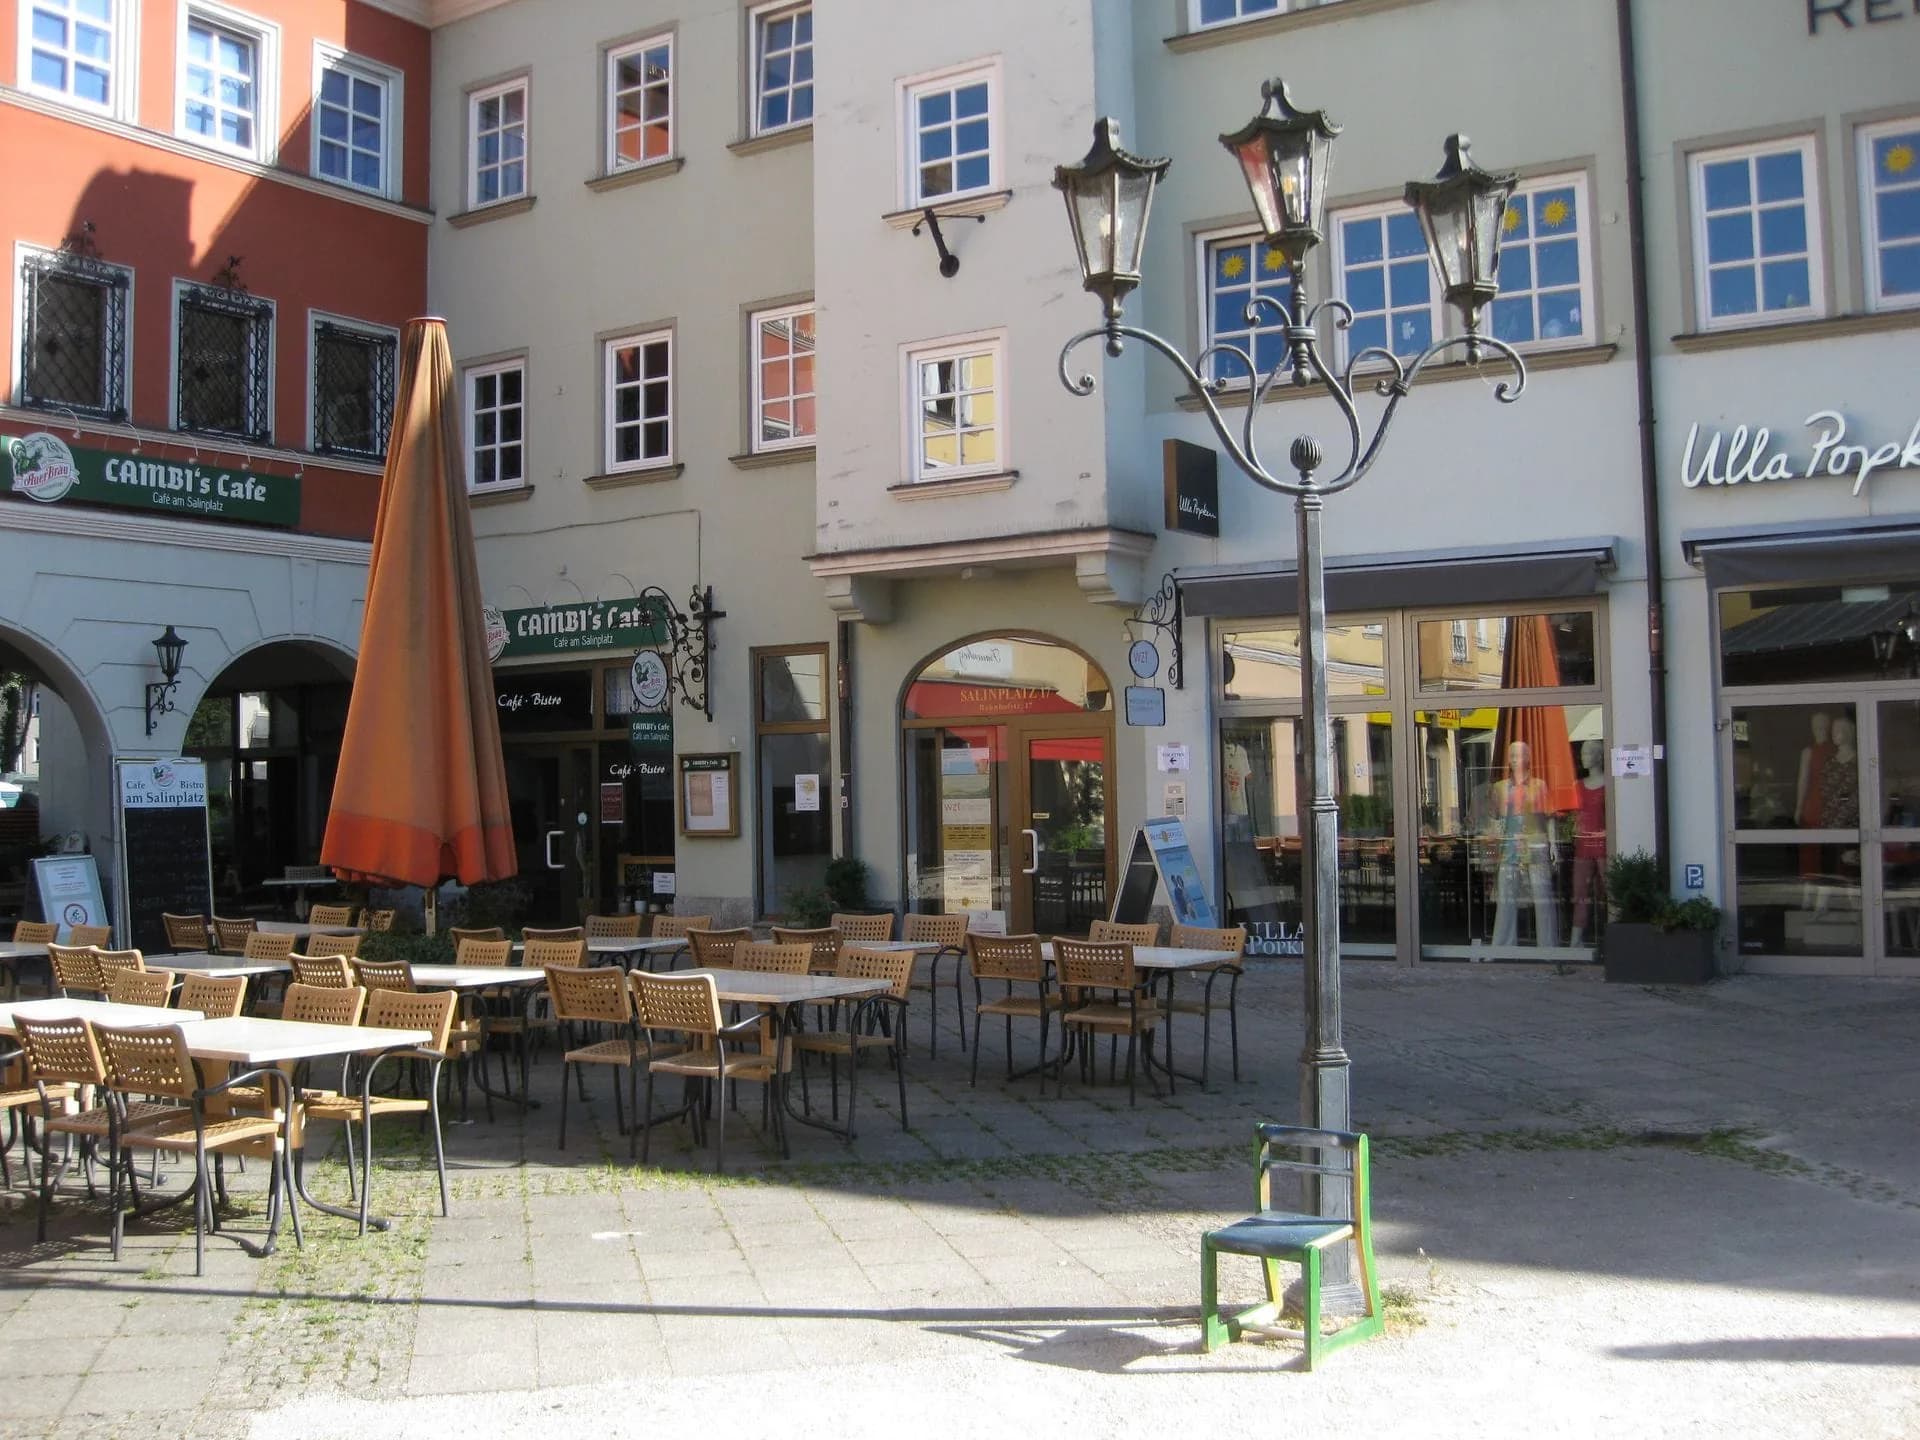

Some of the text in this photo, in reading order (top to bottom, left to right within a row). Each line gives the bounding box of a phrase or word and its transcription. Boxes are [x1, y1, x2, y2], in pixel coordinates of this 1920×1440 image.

[1807, 0, 1920, 36] RE
[1681, 421, 1793, 488] Ulla
[105, 458, 267, 502] CAMBI's Cafe
[172, 496, 185, 507] am
[187, 496, 224, 512] Salinplatz
[570, 637, 580, 647] am
[581, 634, 614, 648] Salinplatz
[498, 692, 562, 712] Café Bistro
[960, 687, 1037, 703] SALINPLATZ
[610, 763, 666, 779] Café Bistro
[179, 780, 204, 789] Bistro
[126, 791, 204, 806] am Salinplatz
